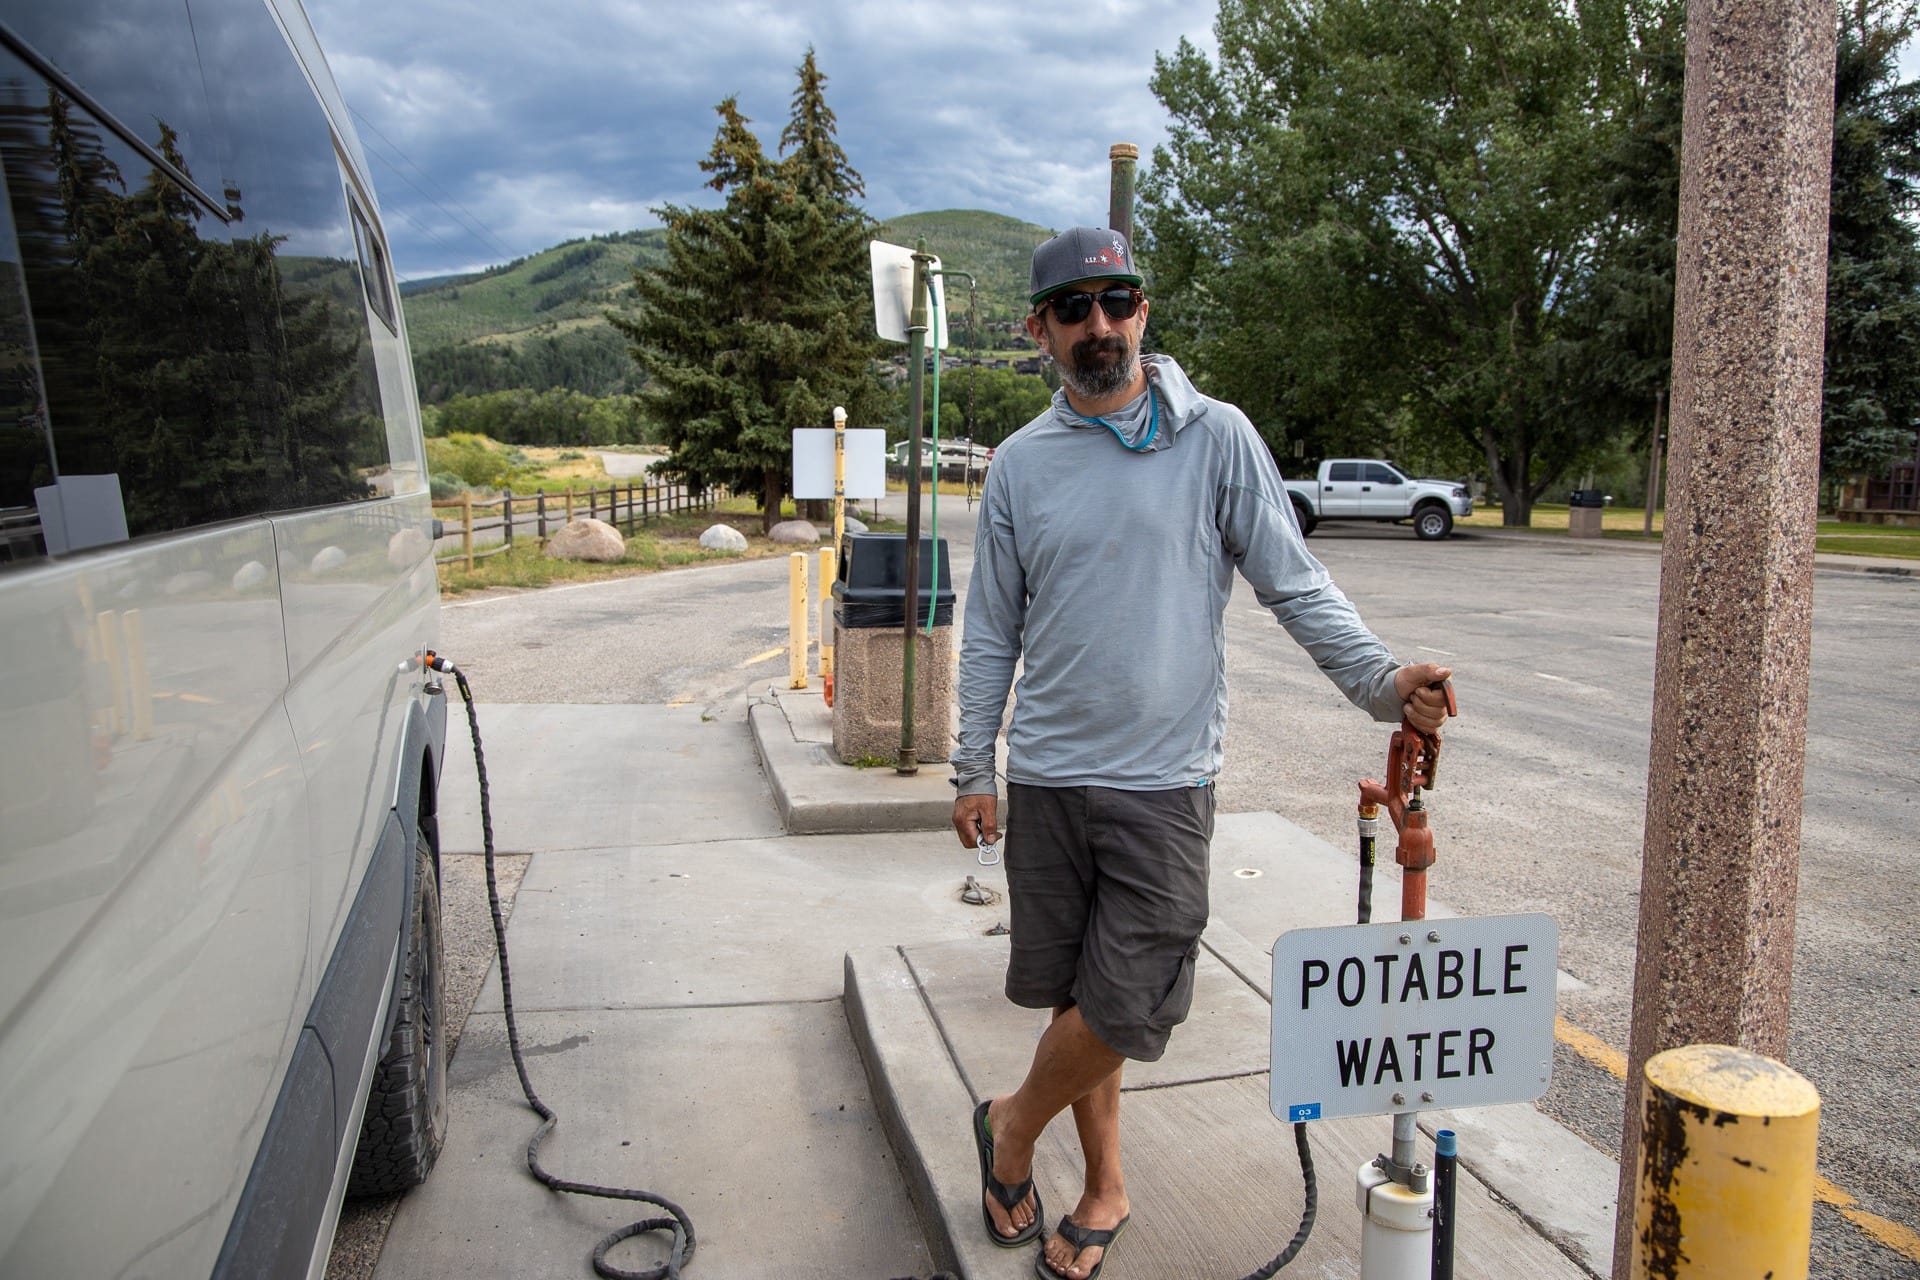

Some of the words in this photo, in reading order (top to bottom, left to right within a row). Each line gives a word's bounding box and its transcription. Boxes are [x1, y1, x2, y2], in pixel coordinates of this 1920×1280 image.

[1301, 944, 1529, 1009] POTABLE
[1336, 1027, 1496, 1088] WATER
[1298, 1108, 1312, 1116] 03
